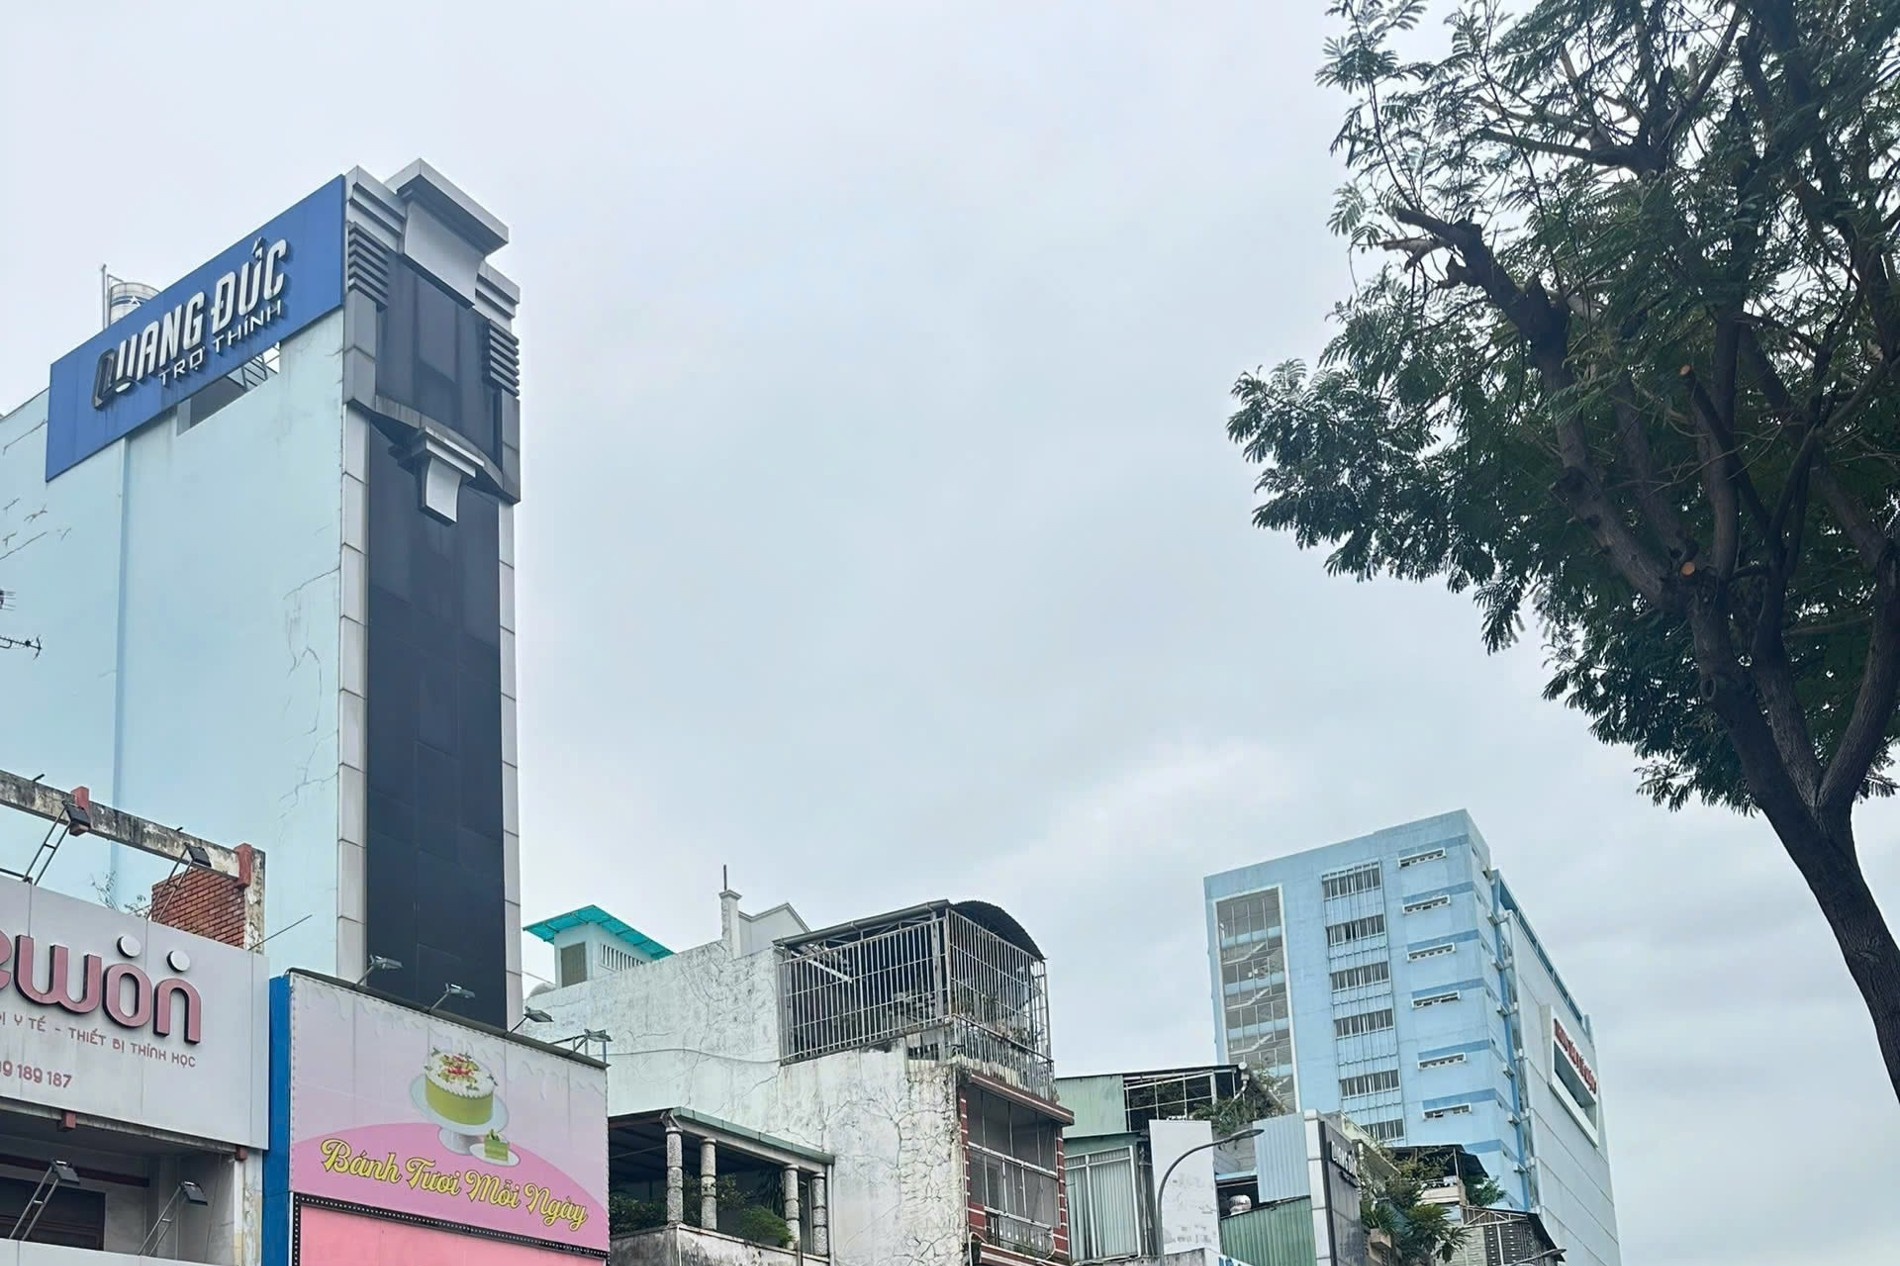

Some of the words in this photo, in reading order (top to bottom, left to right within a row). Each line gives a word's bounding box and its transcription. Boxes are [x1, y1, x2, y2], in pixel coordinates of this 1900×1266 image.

[92, 290, 205, 410] QUANG
[211, 236, 289, 338] ĐỨC
[158, 346, 206, 386] TRỢ
[213, 299, 283, 352] THÍNH
[0, 1060, 13, 1077] 9
[17, 1063, 43, 1084] 189
[47, 1071, 72, 1088] 187
[14, 1014, 22, 1025] Y
[28, 1013, 46, 1031] TẾ
[69, 1027, 106, 1047] THIẾT
[112, 1038, 125, 1053] BỊ
[130, 1043, 167, 1061] THÍNH
[171, 1053, 196, 1068] HỌC
[320, 1138, 402, 1184] Bánh
[405, 1157, 461, 1197] Tươi
[464, 1170, 521, 1209] Mỗi
[525, 1187, 589, 1232] Ngày
